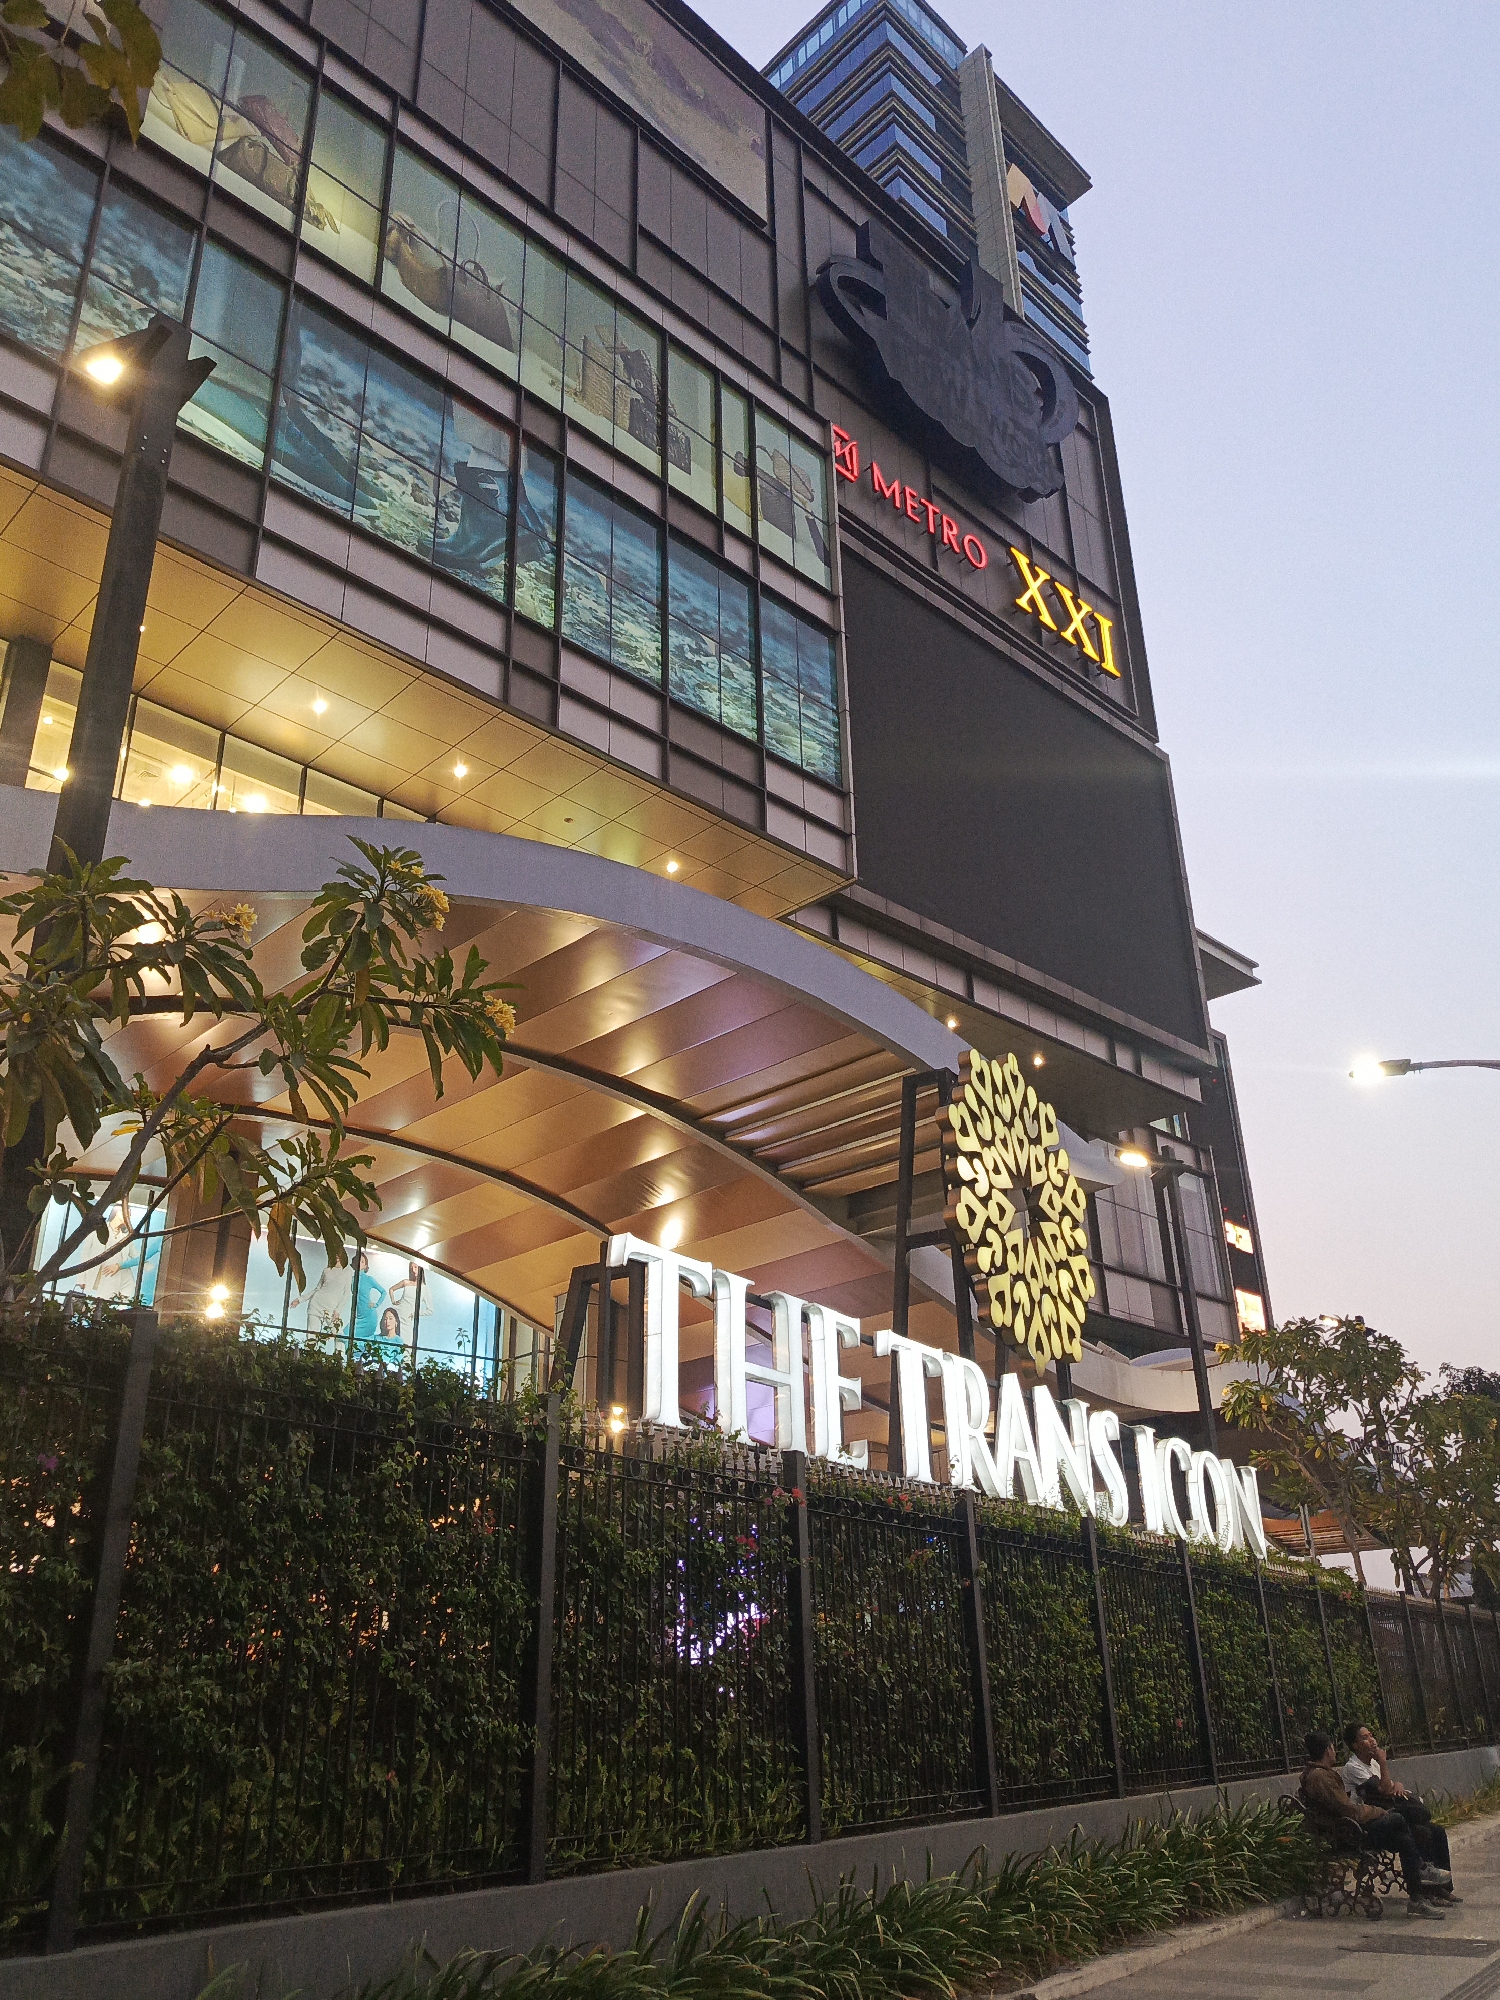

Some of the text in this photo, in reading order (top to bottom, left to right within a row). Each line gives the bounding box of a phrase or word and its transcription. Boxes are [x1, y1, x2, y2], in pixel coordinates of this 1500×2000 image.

[870, 462, 988, 569] METRO
[1011, 547, 1121, 678] XXI
[607, 1232, 1268, 1563] THE TRANS ICON
